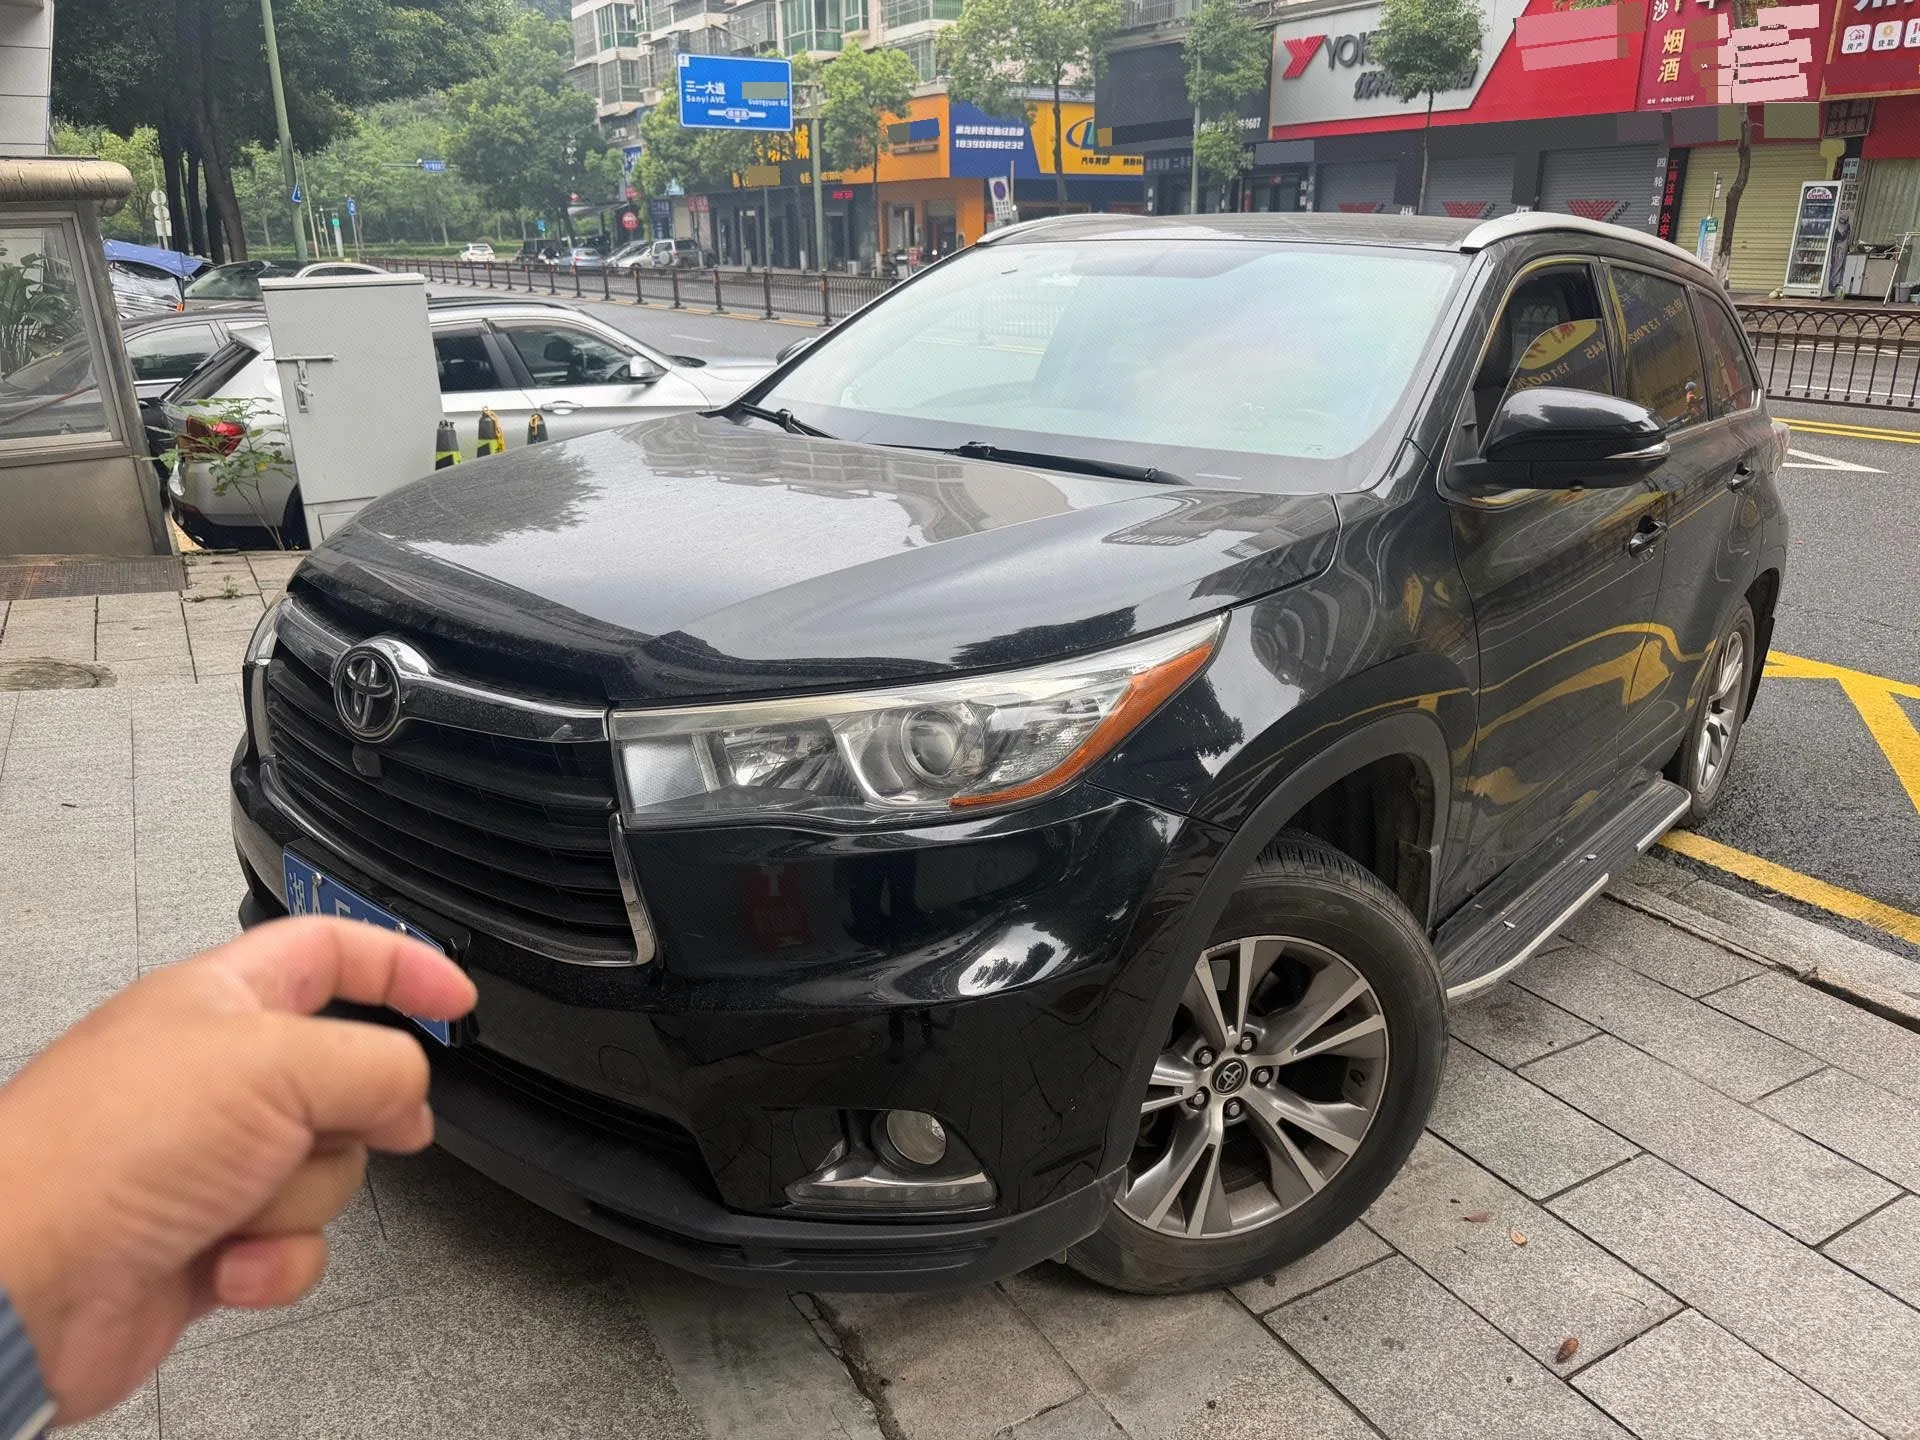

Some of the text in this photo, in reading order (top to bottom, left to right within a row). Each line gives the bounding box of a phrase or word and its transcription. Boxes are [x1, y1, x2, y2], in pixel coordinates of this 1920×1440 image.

[1846, 42, 1864, 51] 房产
[1877, 39, 1894, 48] 贷款
[1657, 28, 1685, 83] 烟酒
[685, 80, 726, 95] 三一大道
[1648, 157, 1667, 225] 四轮定位
